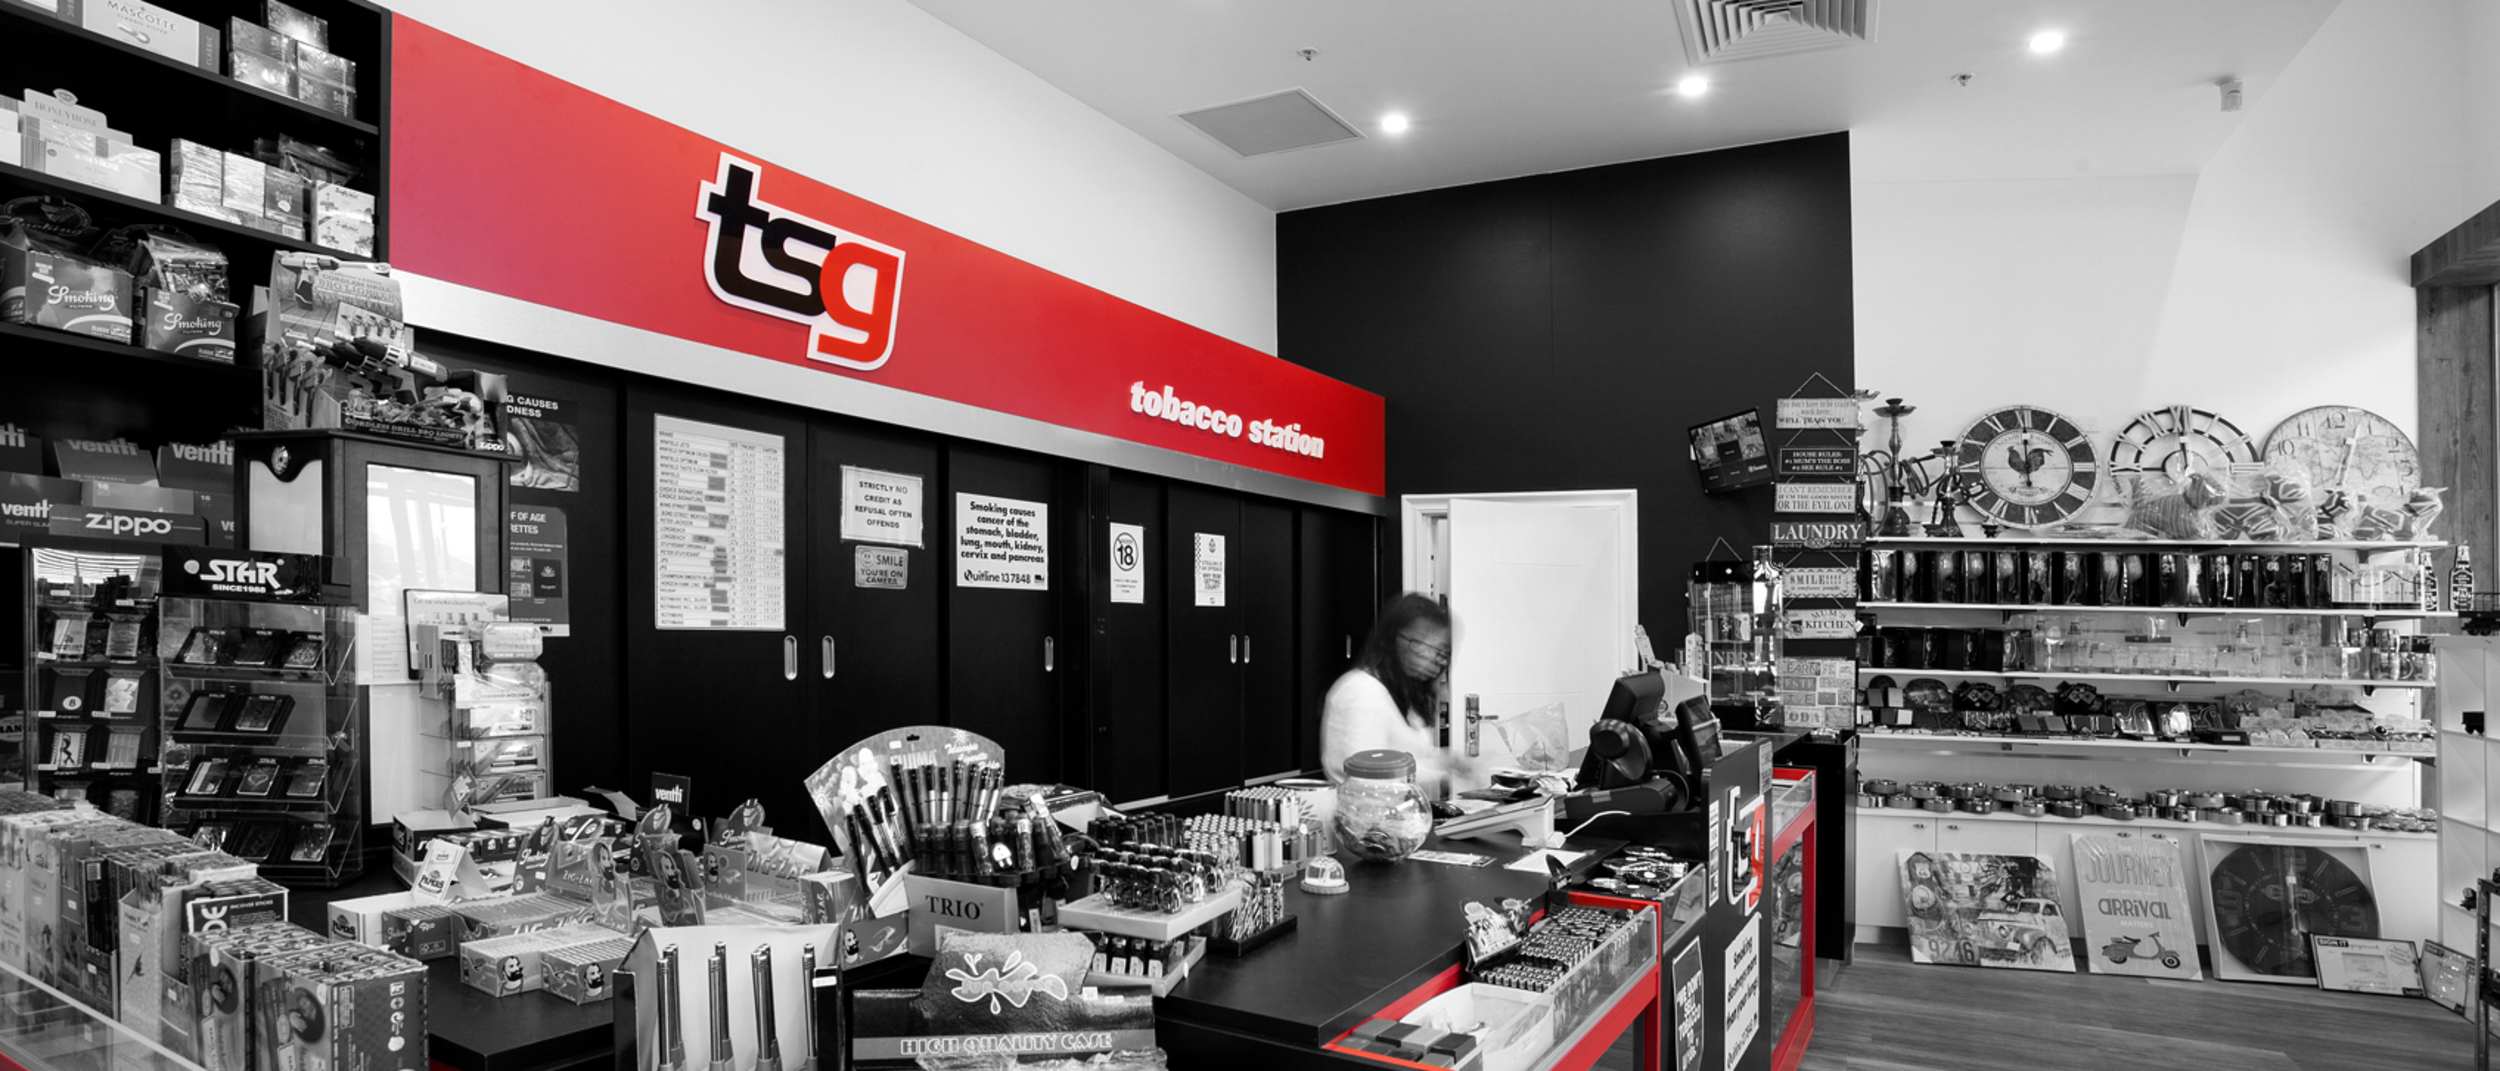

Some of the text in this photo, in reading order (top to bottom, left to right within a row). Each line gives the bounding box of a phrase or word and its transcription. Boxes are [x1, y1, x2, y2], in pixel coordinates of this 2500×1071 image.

[705, 161, 902, 366] tsg
[48, 285, 117, 311] Smoking
[163, 312, 225, 336] Smoking
[516, 396, 559, 410] CAUSES
[1130, 380, 1325, 460] tobacco station
[858, 480, 908, 495] STRICTLY NO
[864, 494, 903, 506] CREDIT AS
[1778, 500, 1852, 510] OR THE EVIL ONE
[517, 512, 529, 522] OF
[530, 513, 547, 523] AGE
[854, 505, 913, 519] REFUSAL OFTEN
[970, 501, 1036, 518] Smoking causes
[866, 518, 900, 529] OFFENDS
[977, 515, 1029, 528] cancer of the
[965, 525, 1040, 542] stomach, bladder,
[1774, 524, 1862, 540] LAUNDRY
[960, 536, 1045, 554] lung, mouth, kidney,
[876, 554, 904, 567] SMILE
[960, 549, 1045, 565] cervix and pancreas
[1116, 545, 1134, 566] 18
[200, 559, 282, 590] STAR
[865, 576, 898, 585] CAMERA
[890, 569, 904, 578] ON
[963, 569, 1000, 583] Quitline
[1804, 619, 1855, 630] KITCHEN
[2085, 853, 2174, 888] JOURNEY
[925, 896, 981, 920] TRIO
[900, 1031, 1114, 1055] HIGH QUALITY CASE
